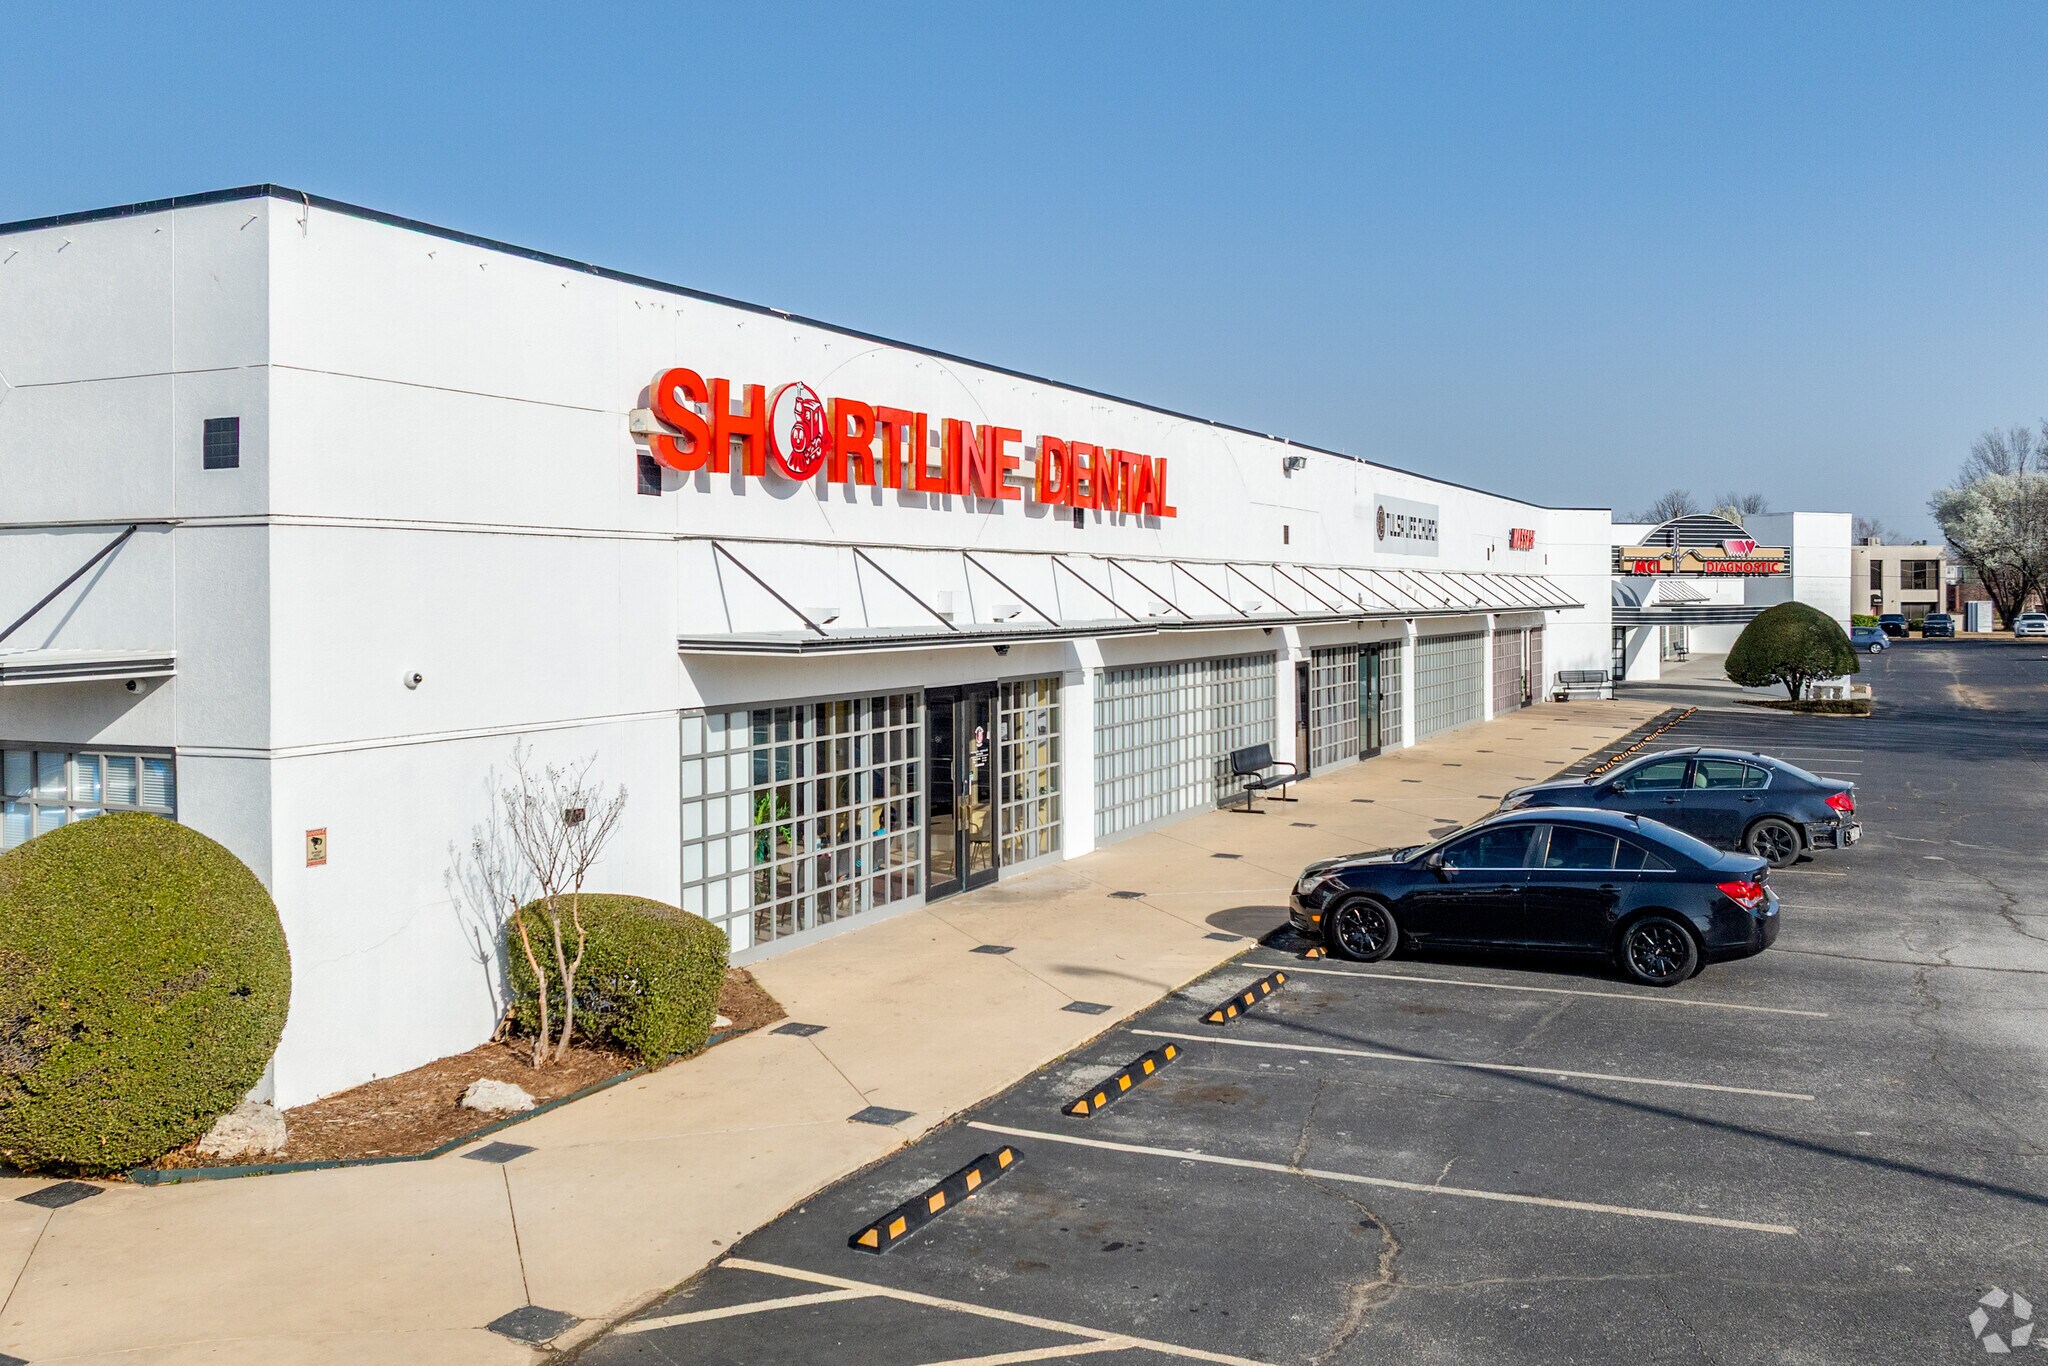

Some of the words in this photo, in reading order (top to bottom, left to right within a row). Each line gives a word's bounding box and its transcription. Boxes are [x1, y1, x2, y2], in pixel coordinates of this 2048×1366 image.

[650, 367, 1022, 500] SHORTLINE
[1035, 434, 1177, 518] DENTAL
[1633, 560, 1661, 573] MCI
[1705, 561, 1778, 573] DIAGNOSTIC
